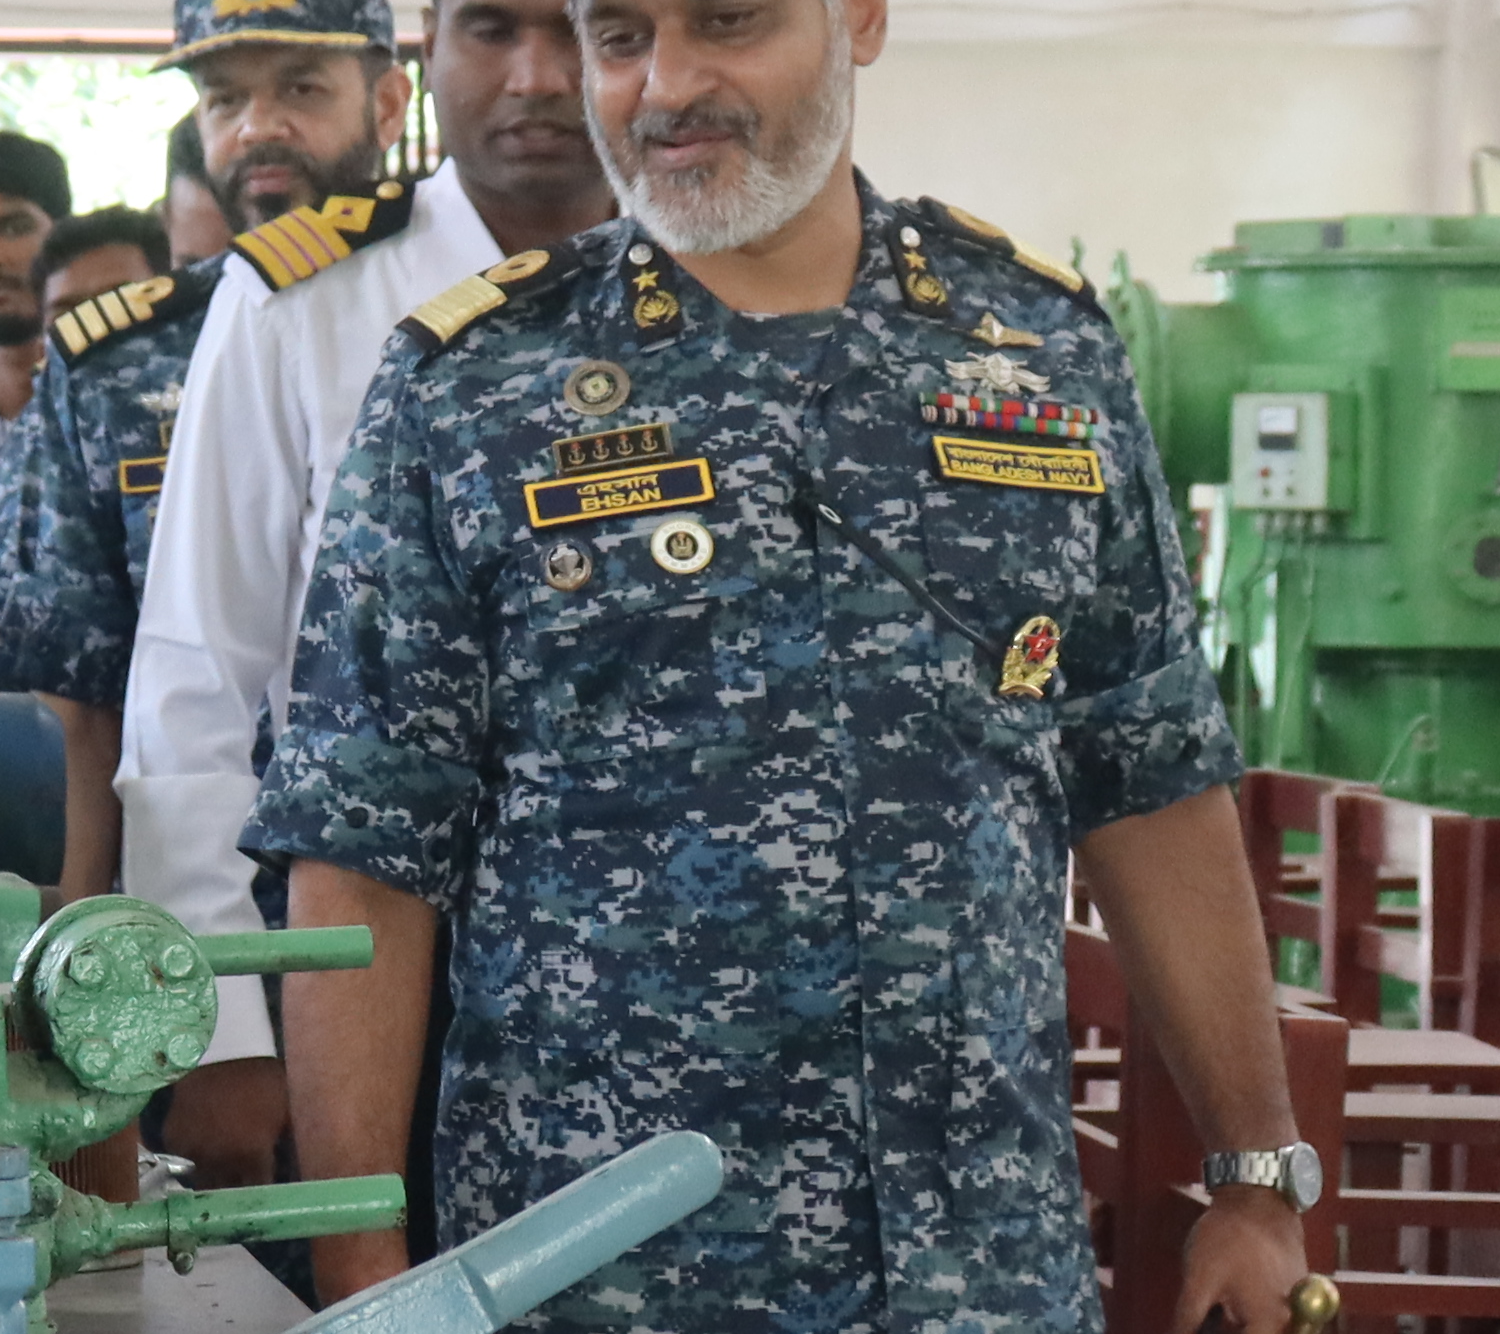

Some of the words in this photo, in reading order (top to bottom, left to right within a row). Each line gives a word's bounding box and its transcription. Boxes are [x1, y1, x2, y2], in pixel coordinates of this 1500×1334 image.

[951, 460, 1045, 481] BANGLADESH
[1049, 471, 1090, 485] NAVY
[581, 487, 662, 512] EHSAN
